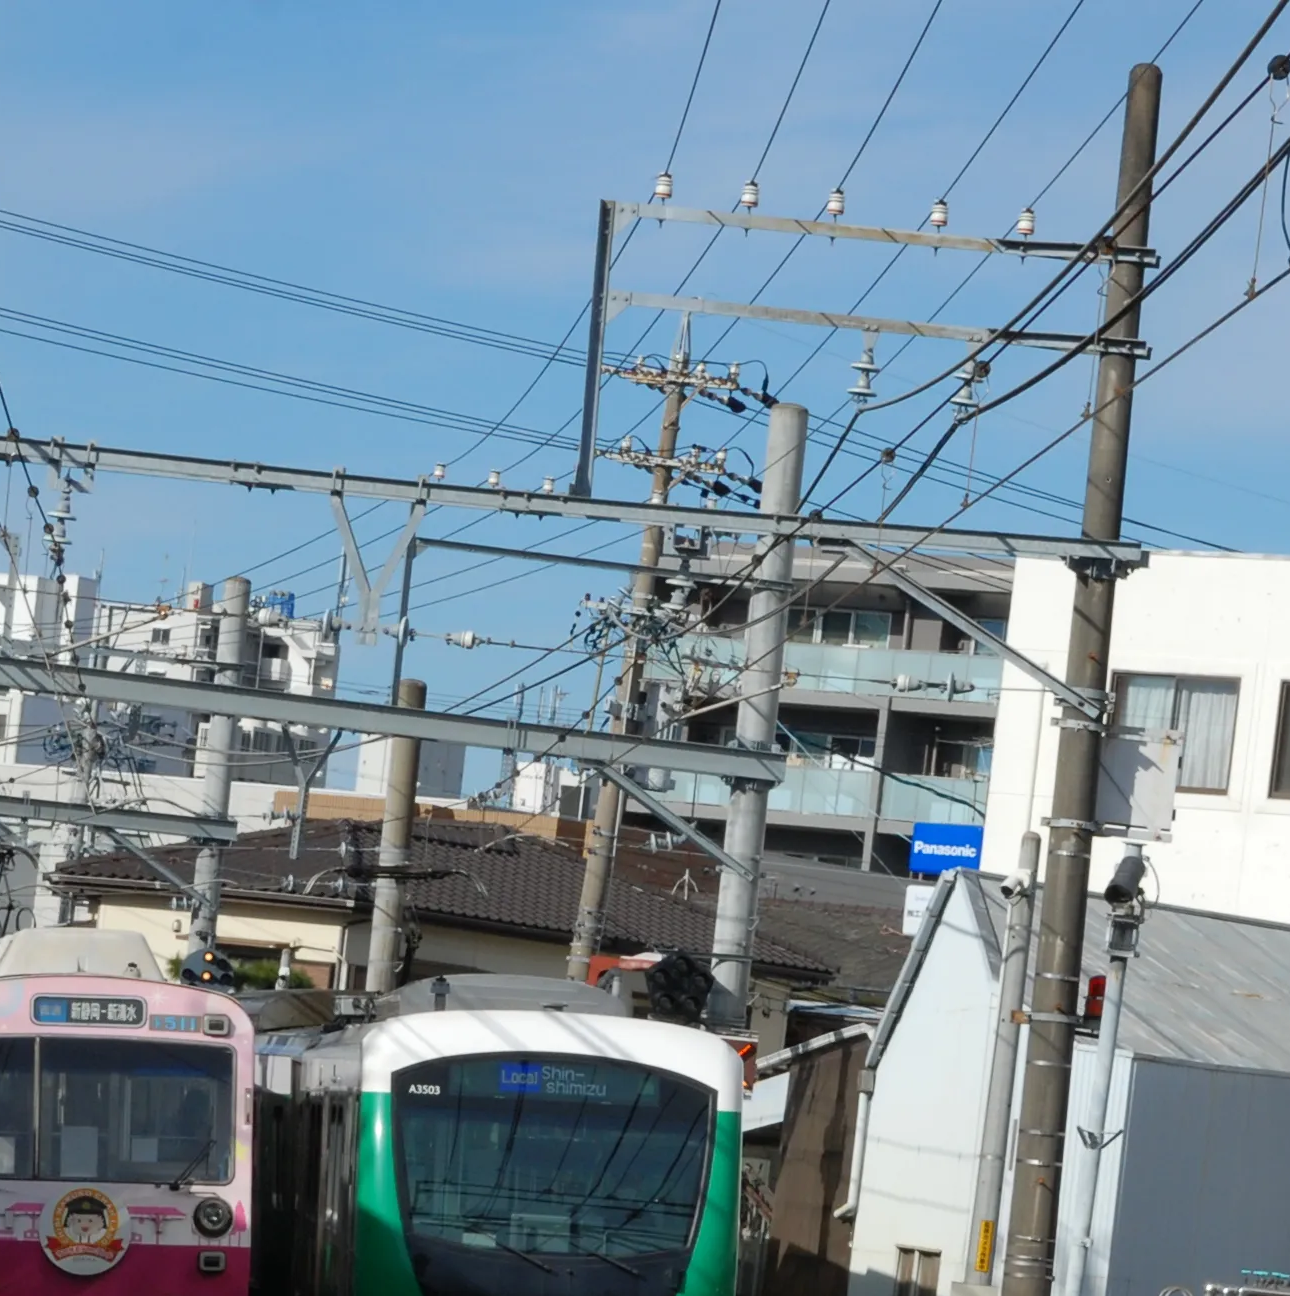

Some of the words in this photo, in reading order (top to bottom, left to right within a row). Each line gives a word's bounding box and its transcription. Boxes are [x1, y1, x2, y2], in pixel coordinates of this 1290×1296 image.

[913, 840, 977, 858] Panasonic
[501, 1069, 538, 1085] Local
[542, 1066, 586, 1081] Shin-
[408, 1084, 441, 1095] A3503
[545, 1080, 608, 1097] shimizu
